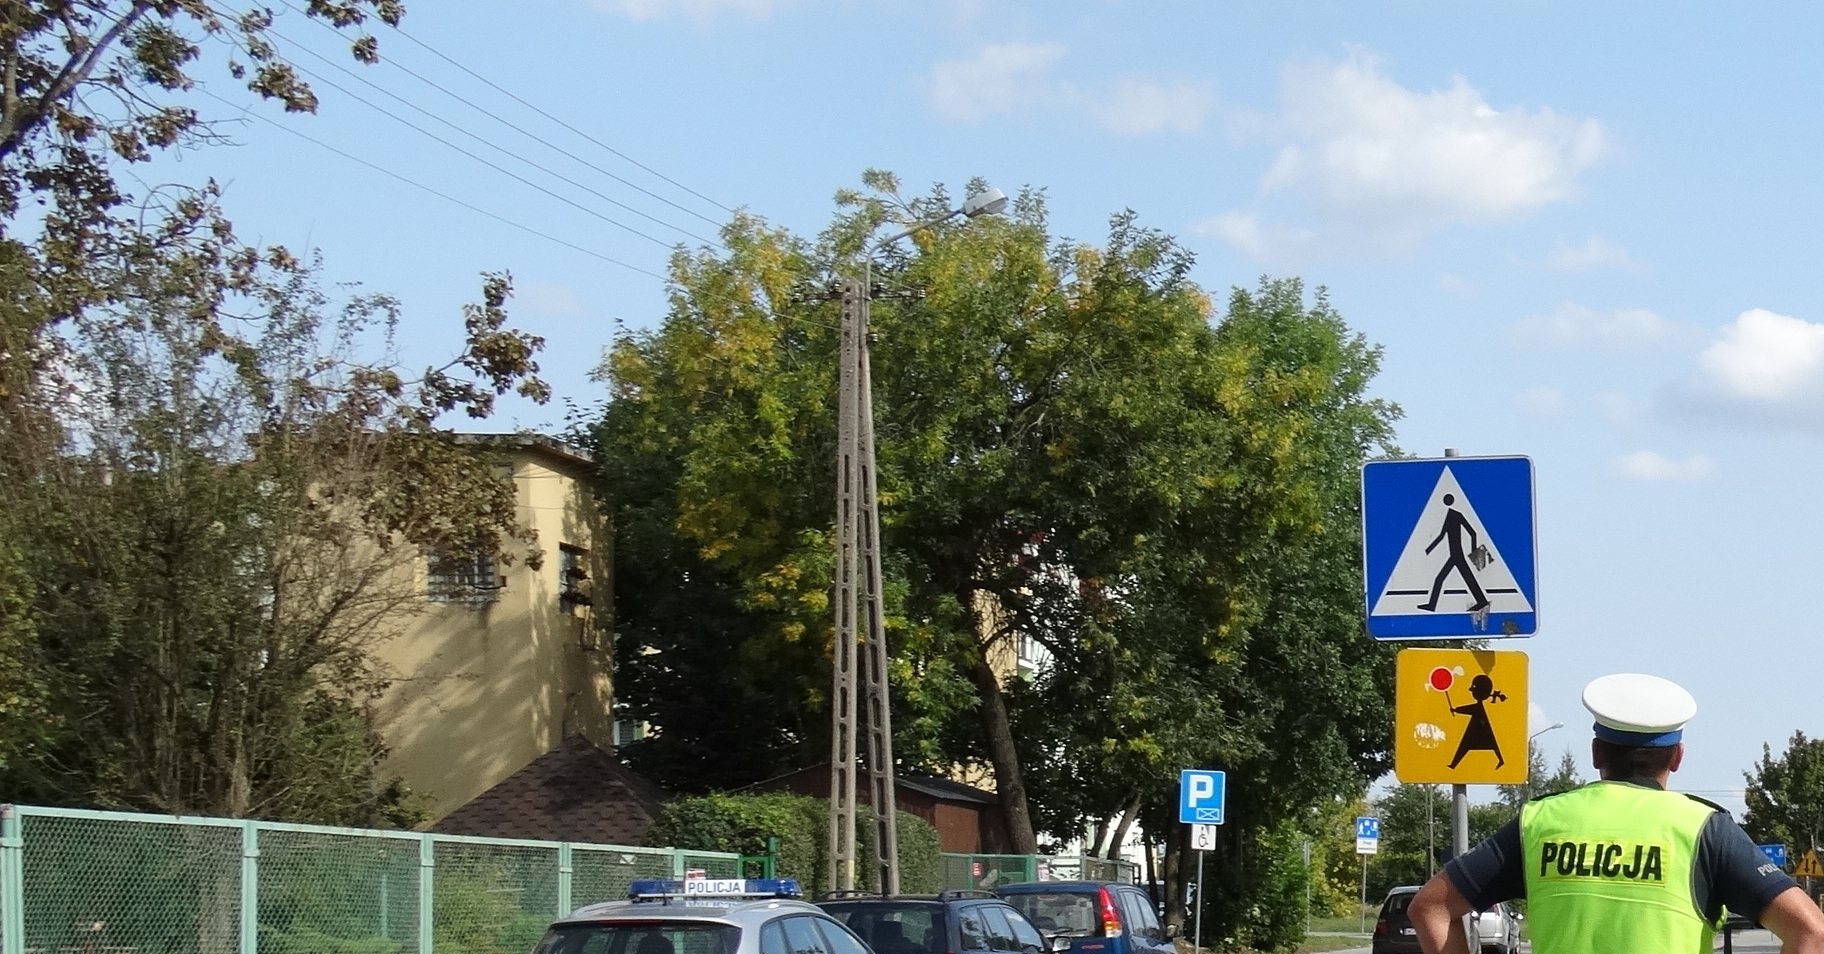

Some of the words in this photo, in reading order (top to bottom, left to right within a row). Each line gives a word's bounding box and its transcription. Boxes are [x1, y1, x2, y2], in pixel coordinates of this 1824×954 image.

[1188, 775, 1214, 807] P
[1540, 841, 1663, 881] POLICJA
[687, 881, 742, 894] POLICJA
